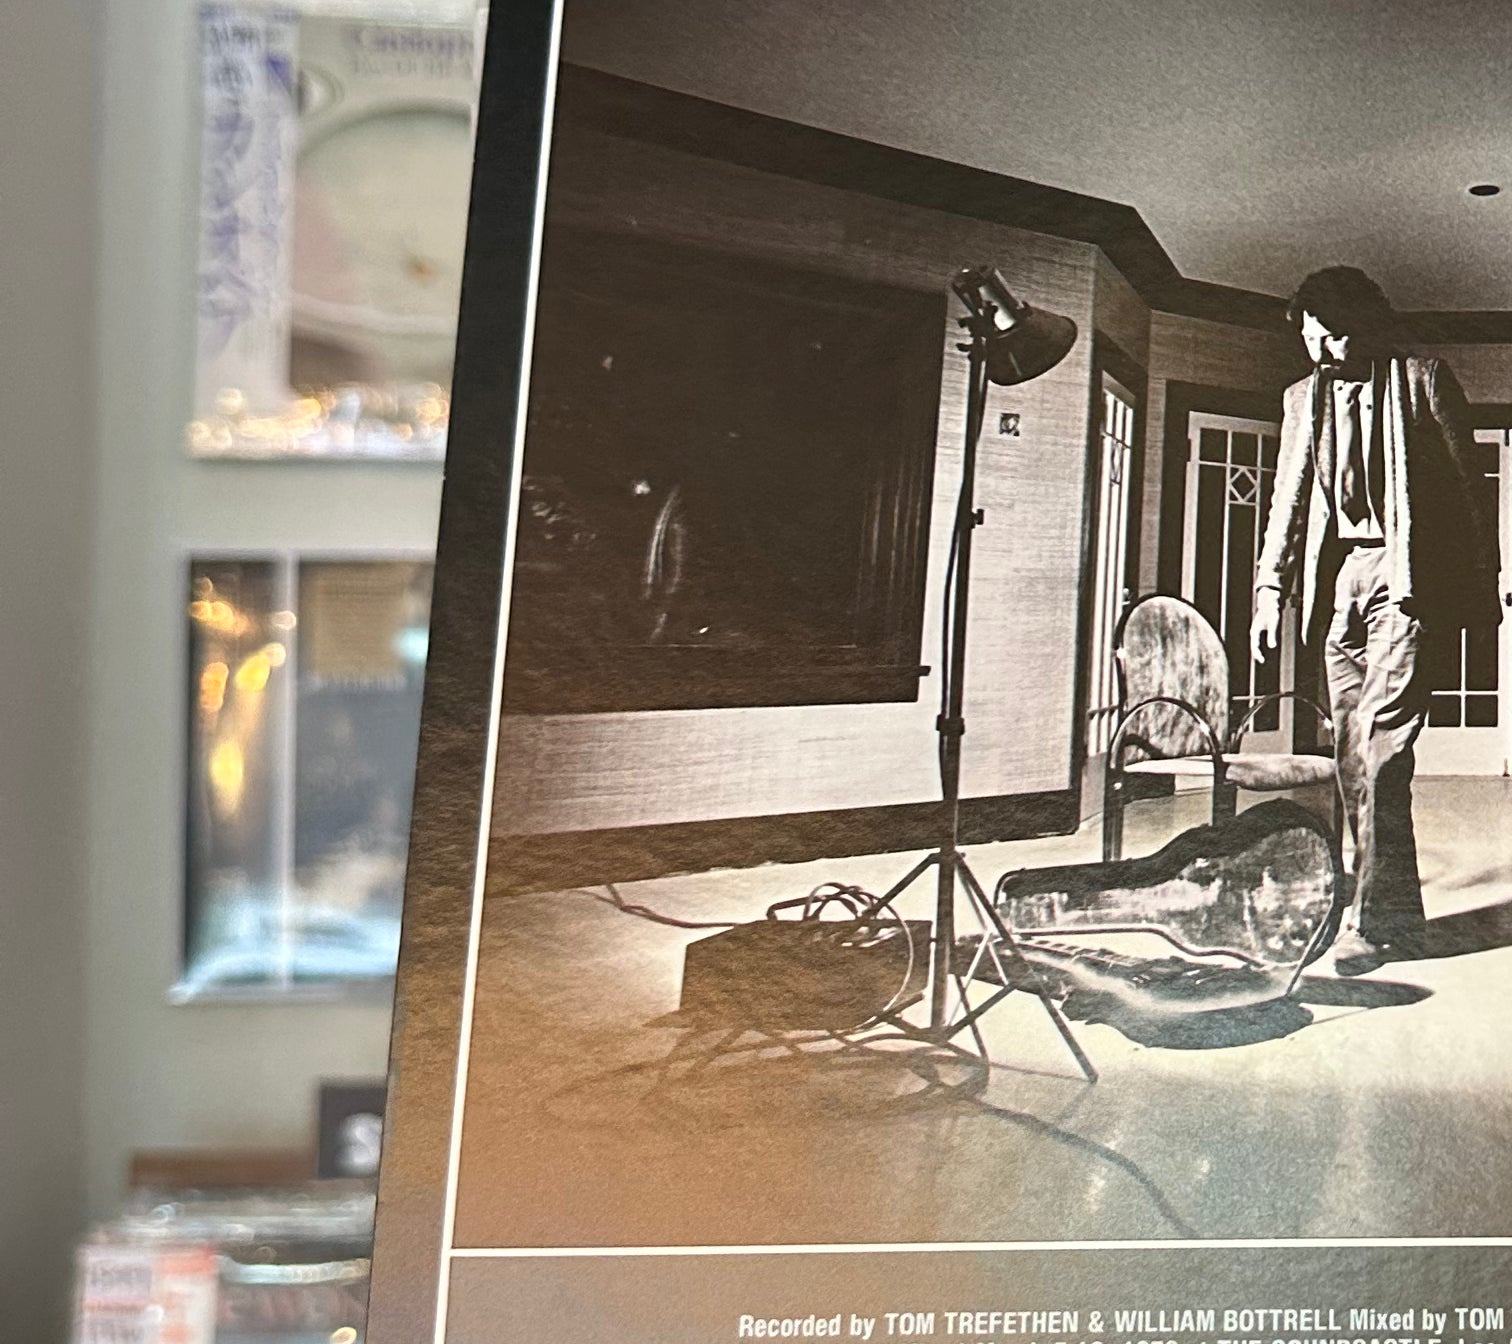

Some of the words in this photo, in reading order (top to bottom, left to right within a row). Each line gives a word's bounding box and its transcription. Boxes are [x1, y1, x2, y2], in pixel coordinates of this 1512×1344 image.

[738, 1314, 842, 1338] Recorded
[849, 1313, 876, 1340] by
[883, 1312, 935, 1336] TOM
[943, 1311, 1079, 1335] TREFETHEN
[1087, 1310, 1105, 1333] &
[1114, 1309, 1215, 1333] WILLIAM
[1223, 1308, 1342, 1332] BOTTRELL
[1349, 1308, 1415, 1331] Mixed
[1421, 1308, 1447, 1335] by
[1454, 1308, 1504, 1331] TOM
